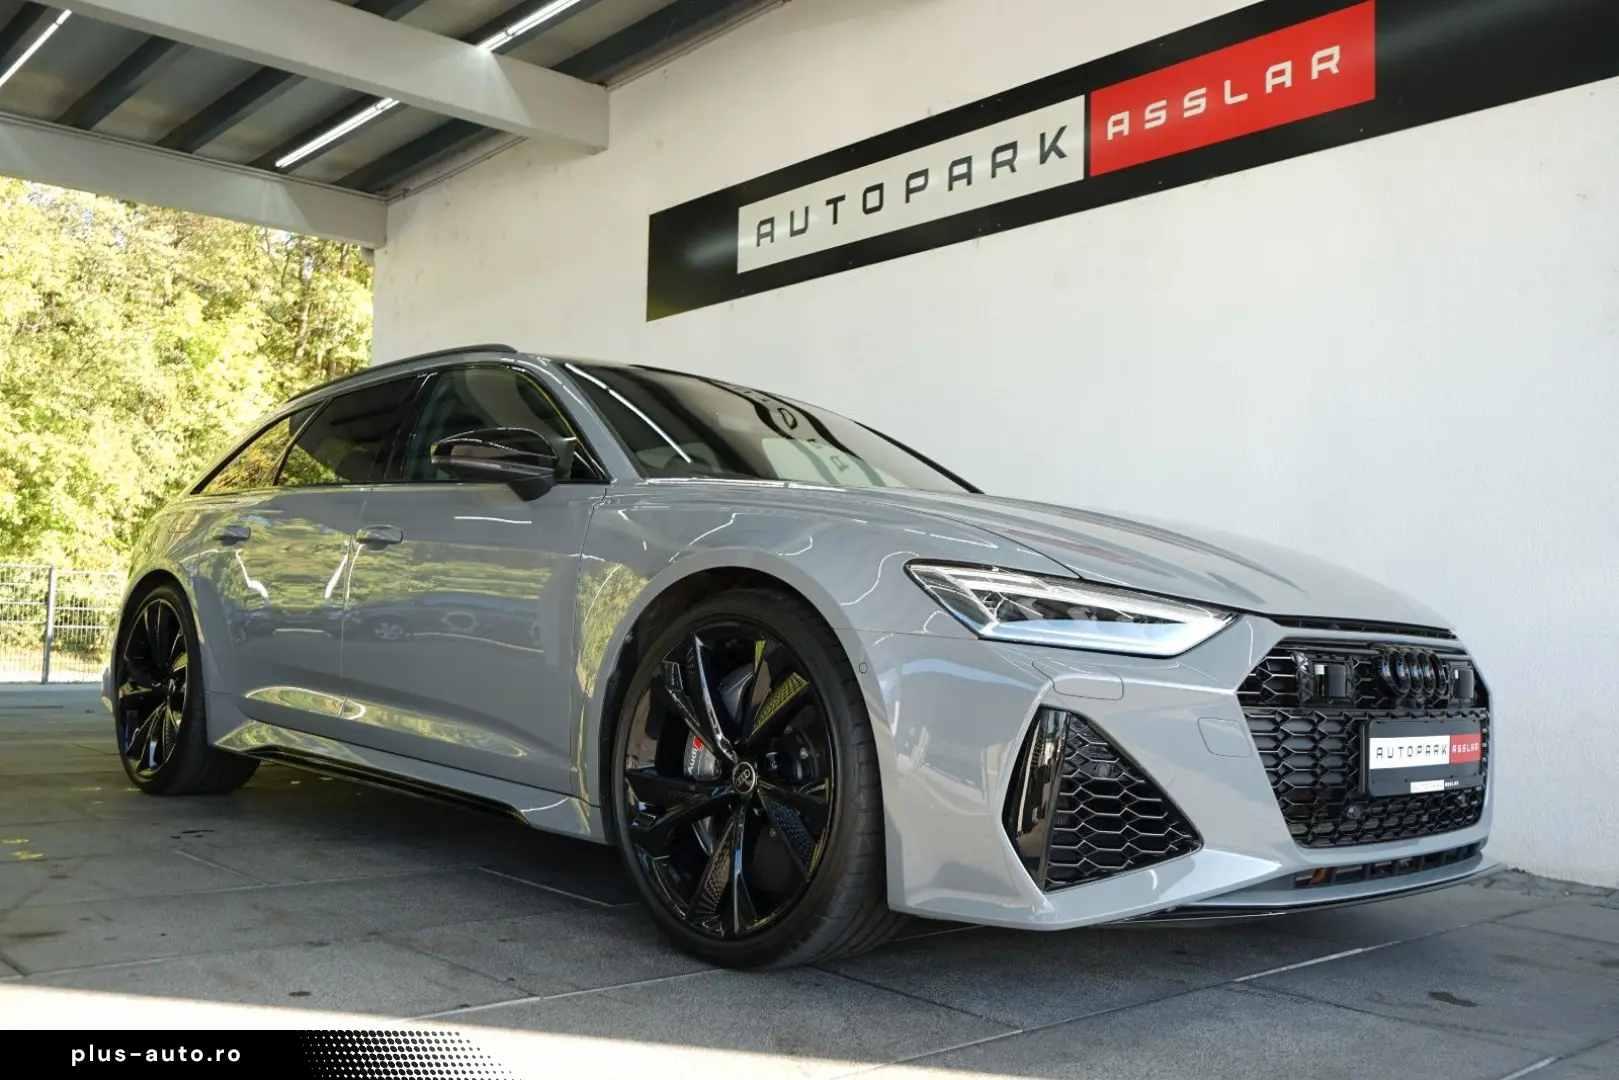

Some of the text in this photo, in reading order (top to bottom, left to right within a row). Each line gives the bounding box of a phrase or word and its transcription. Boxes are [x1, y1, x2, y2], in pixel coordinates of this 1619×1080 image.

[756, 45, 1341, 247] AUTOPARK ASSLAR
[687, 747, 698, 775] Audi
[1376, 744, 1447, 758] AUTOPARK
